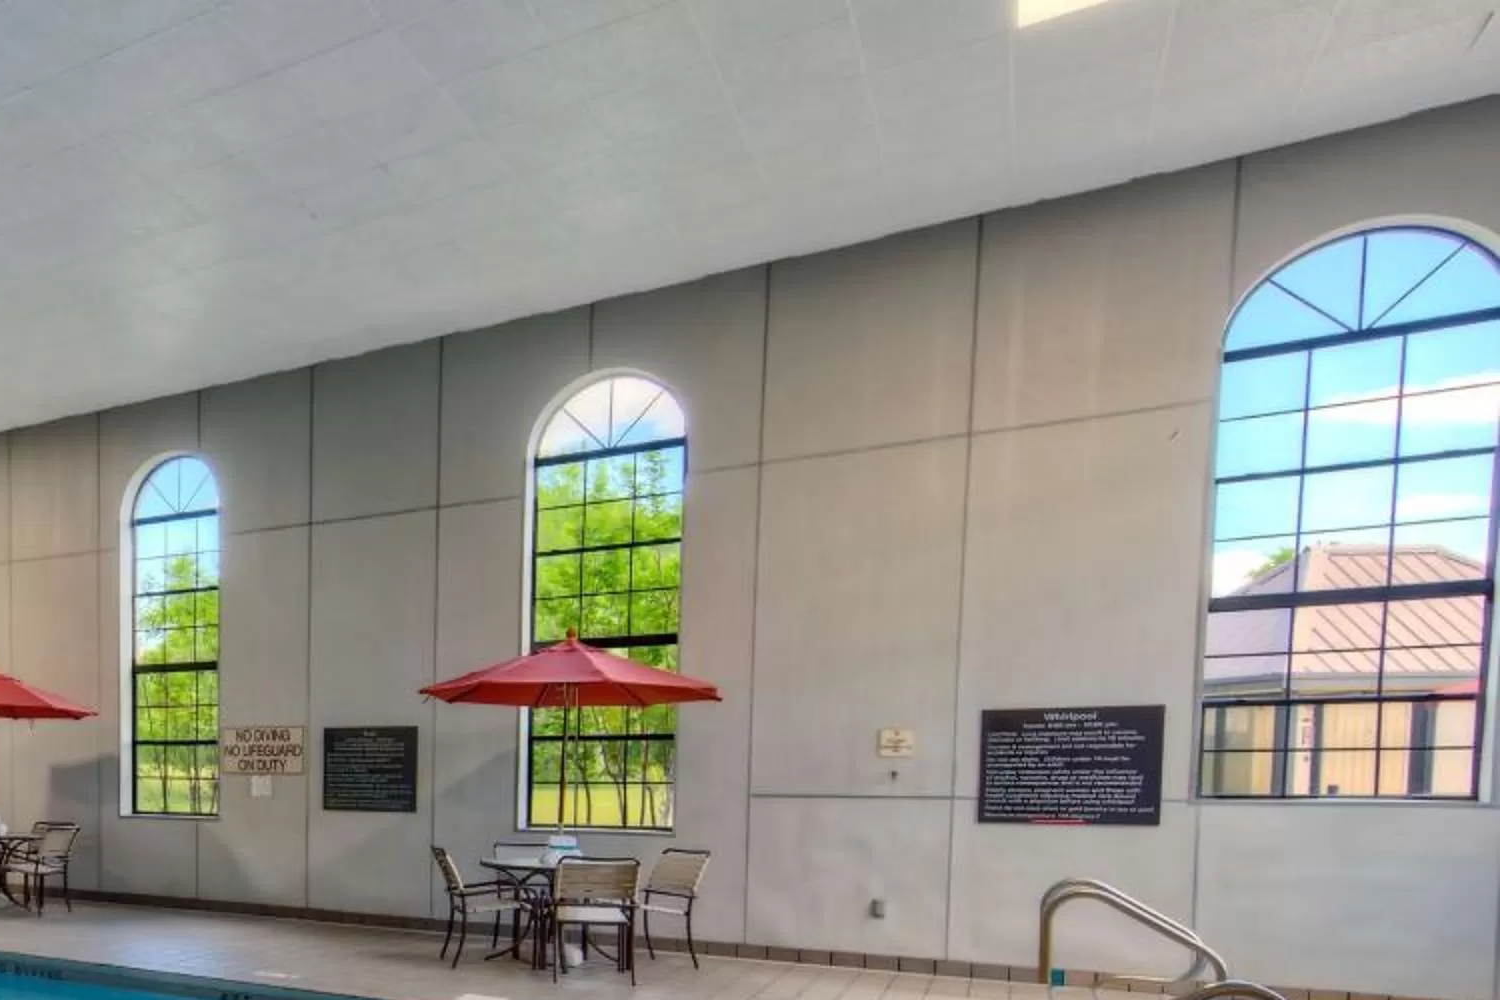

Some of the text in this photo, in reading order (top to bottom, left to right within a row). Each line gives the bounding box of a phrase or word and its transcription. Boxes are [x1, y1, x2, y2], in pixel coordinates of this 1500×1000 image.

[235, 729, 291, 742] NO DIVING
[223, 744, 303, 757] NO LIFEGUARD
[237, 759, 287, 772] ON DUTY
